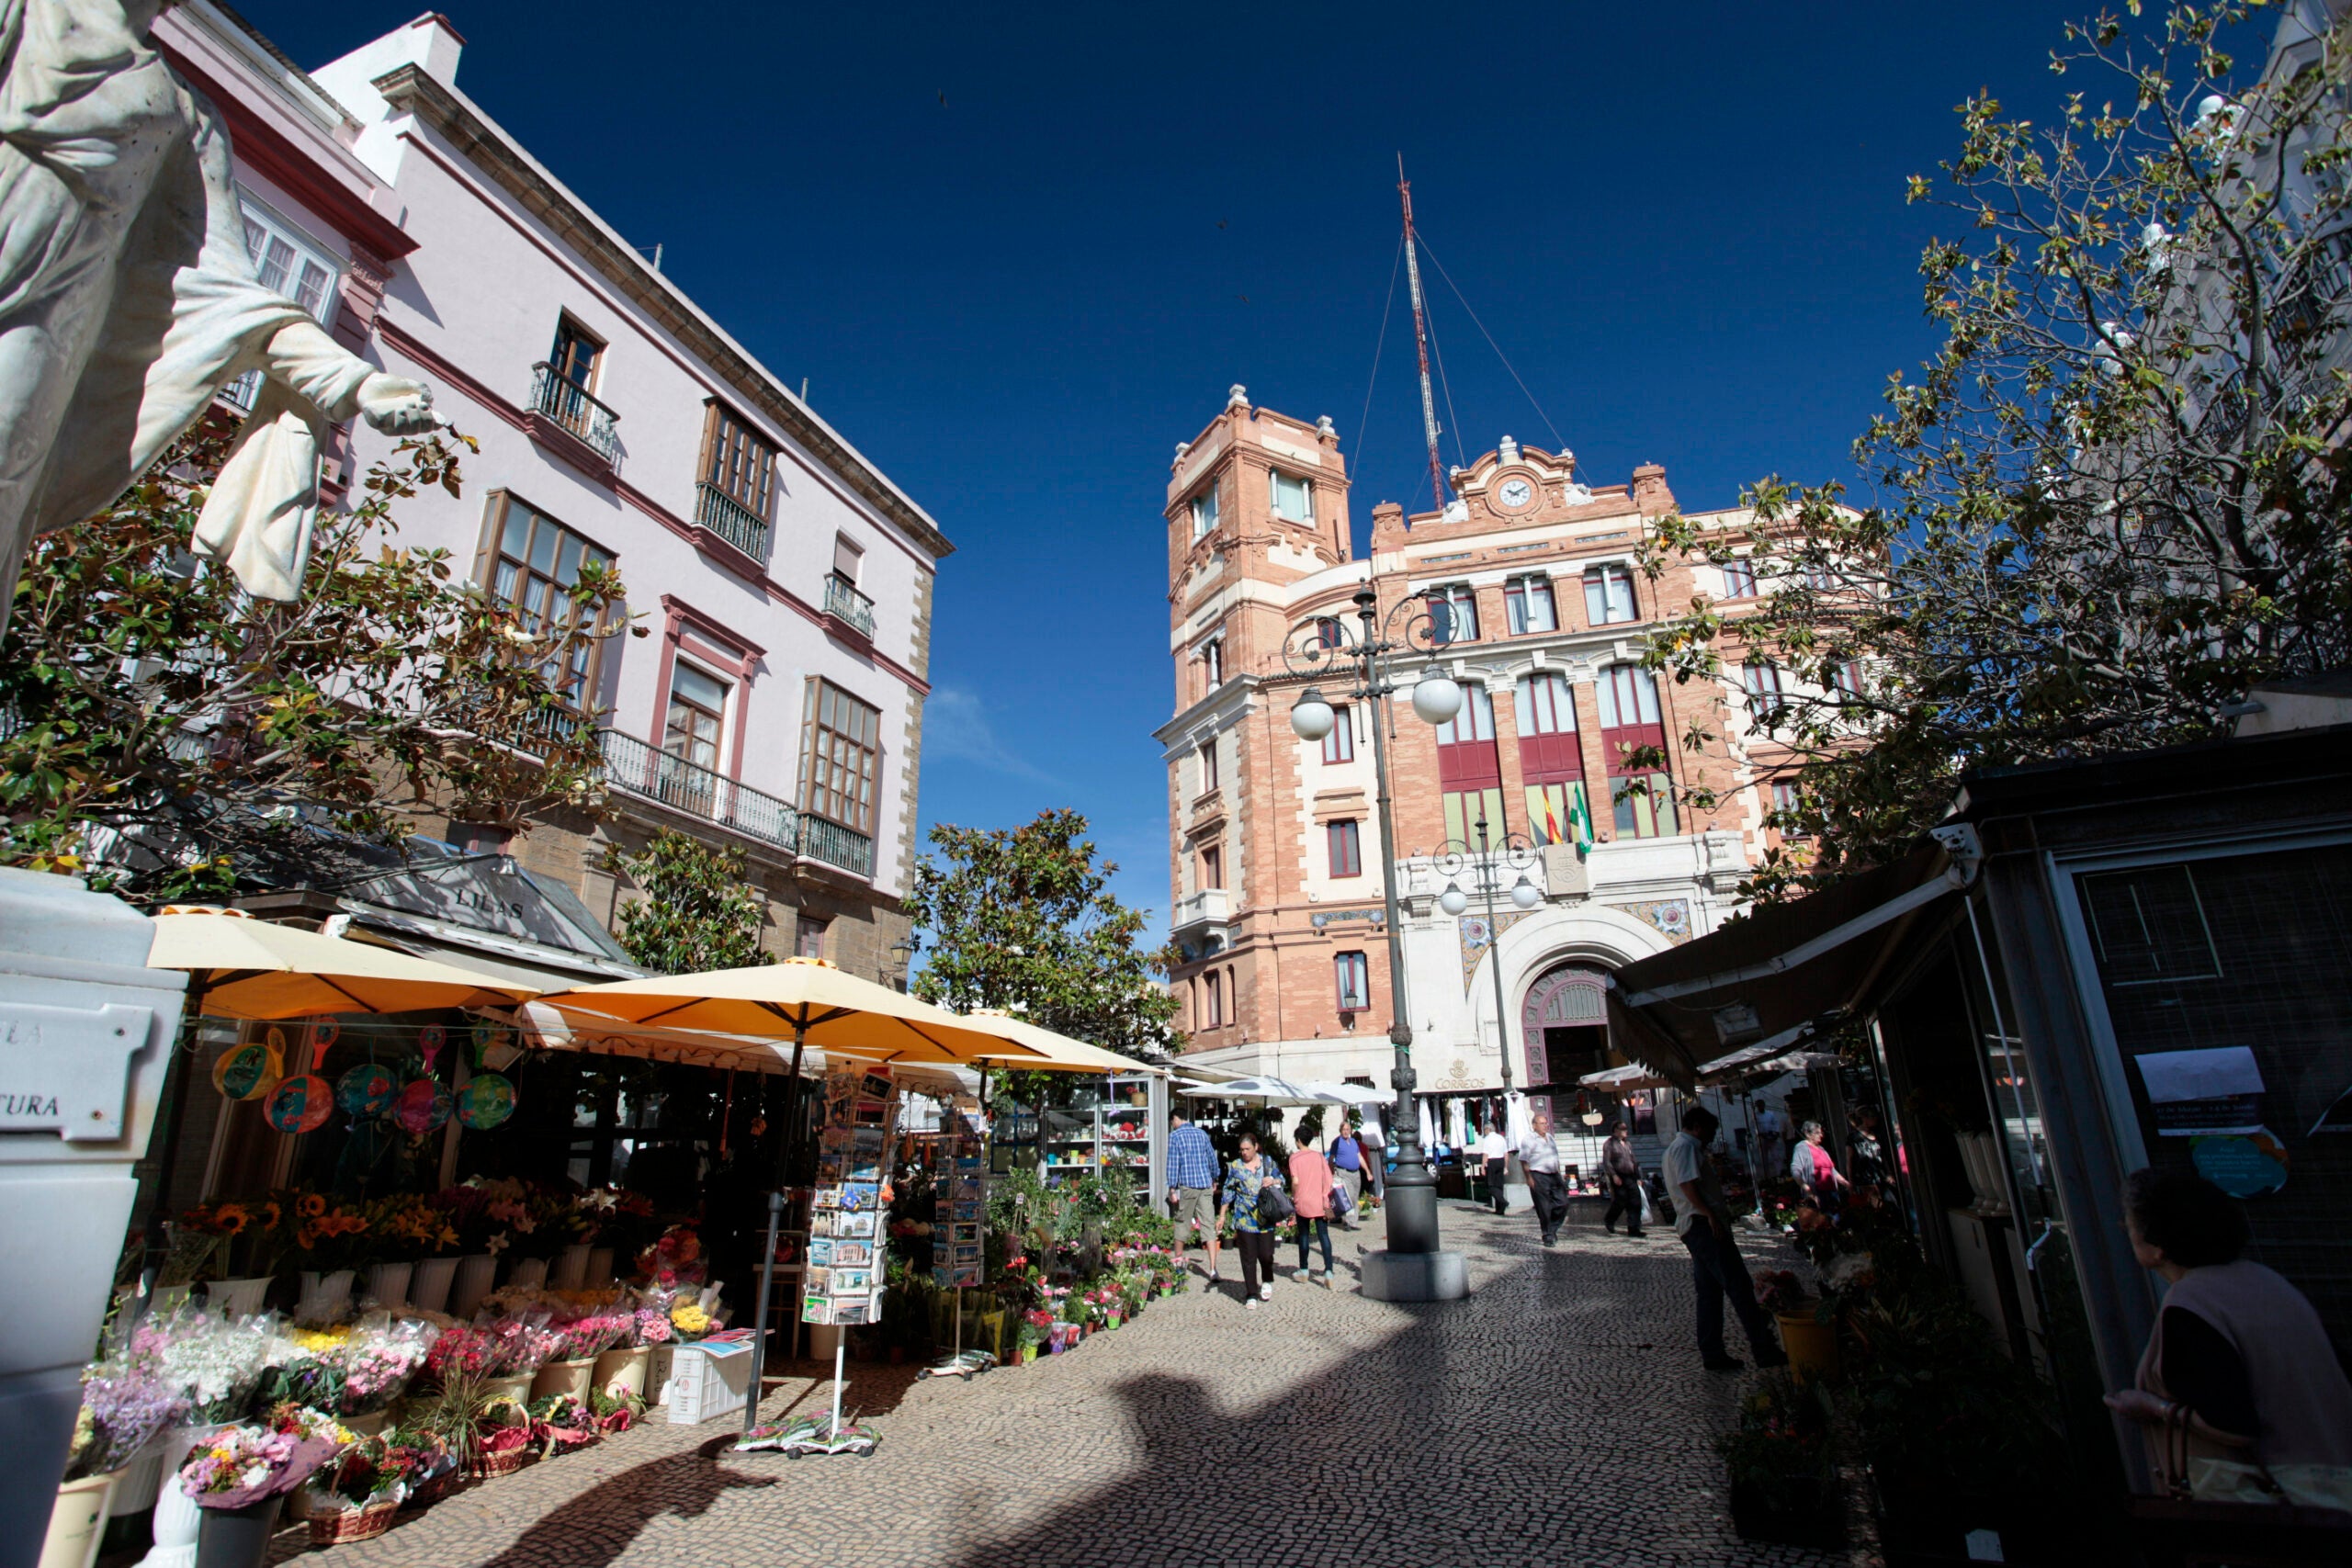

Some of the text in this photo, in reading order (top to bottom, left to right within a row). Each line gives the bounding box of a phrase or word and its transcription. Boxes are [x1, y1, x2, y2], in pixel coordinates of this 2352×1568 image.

[456, 889, 523, 919] LILAS
[0, 1020, 43, 1044] LA
[1435, 1077, 1486, 1089] CORREOS
